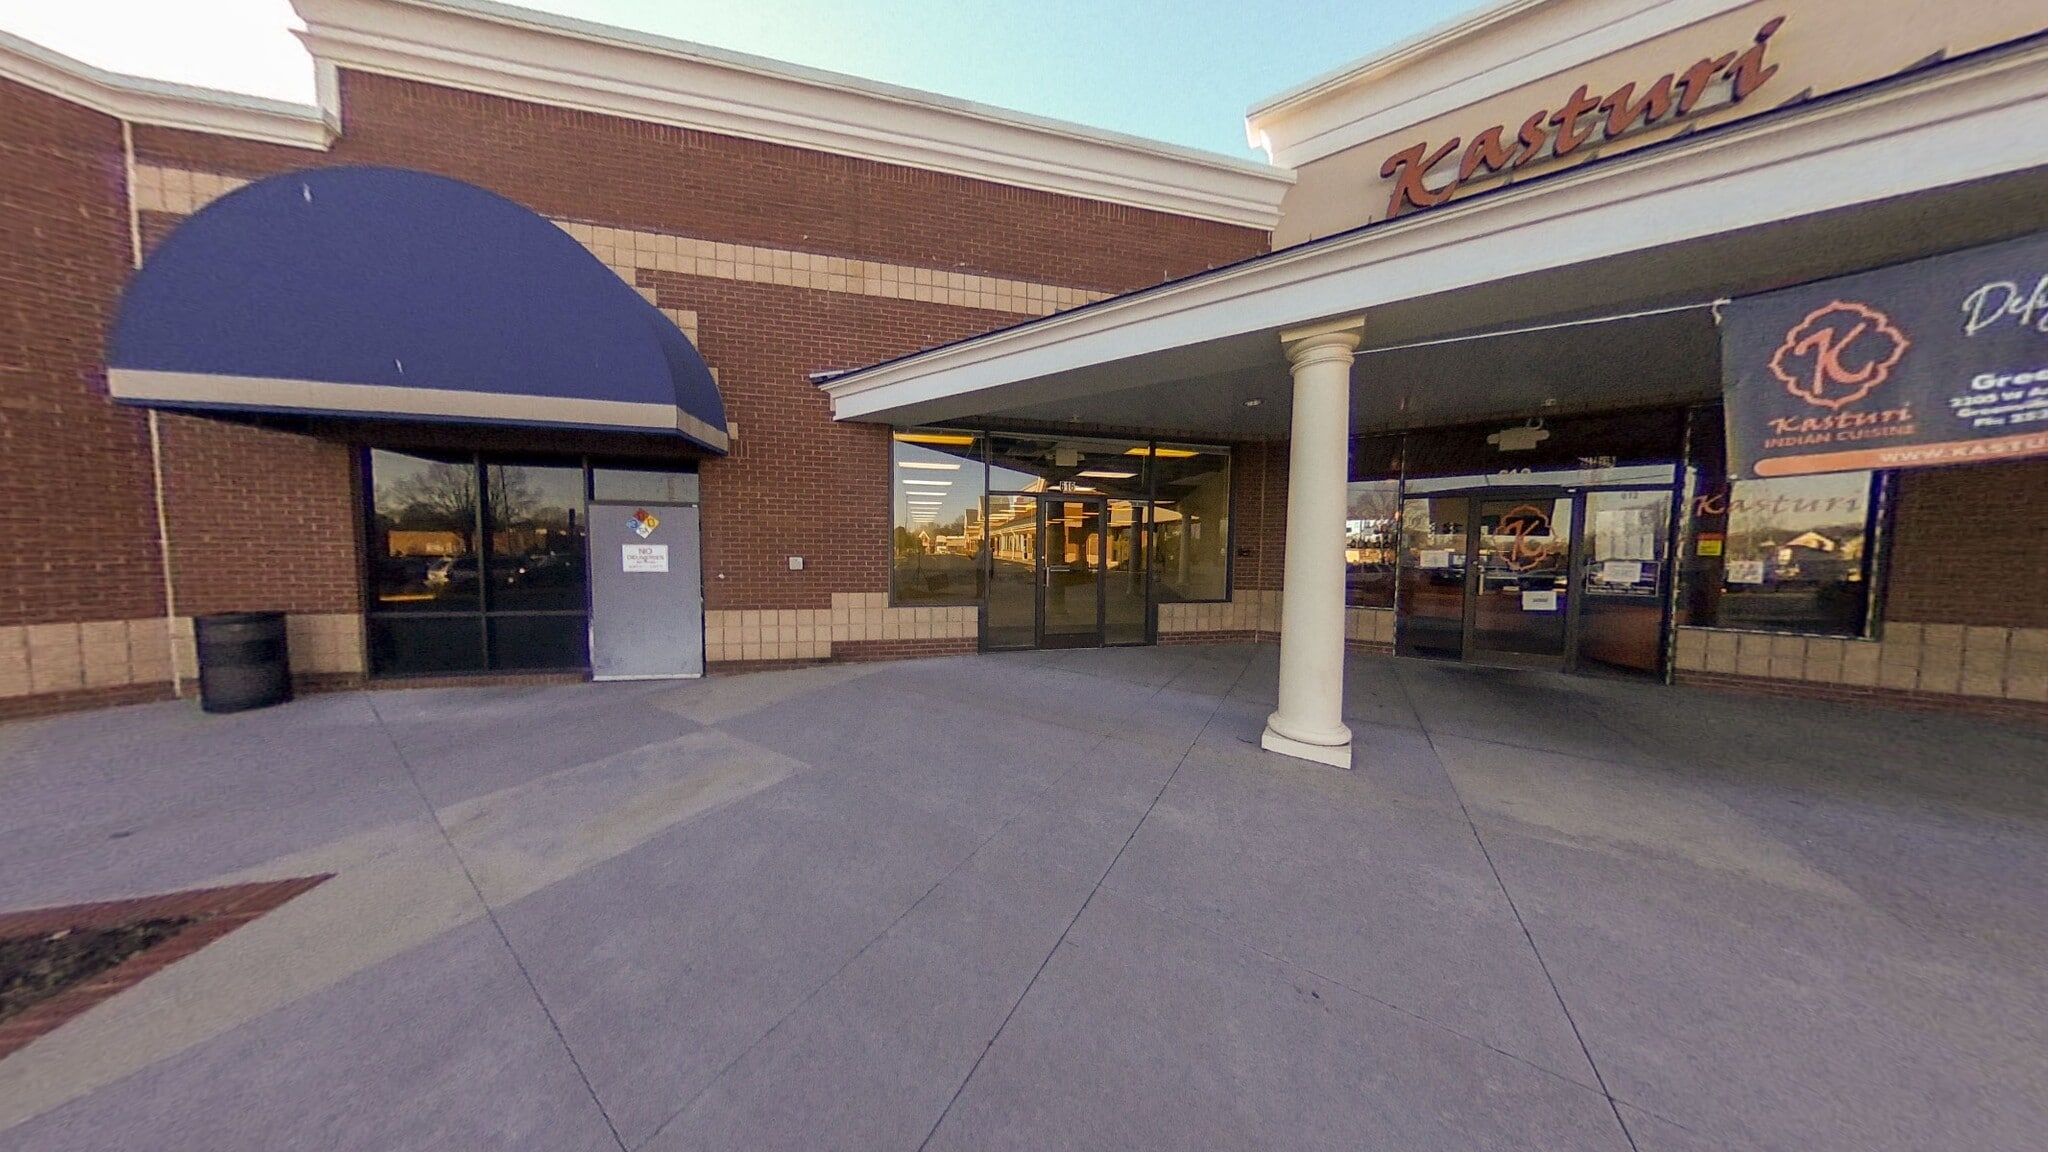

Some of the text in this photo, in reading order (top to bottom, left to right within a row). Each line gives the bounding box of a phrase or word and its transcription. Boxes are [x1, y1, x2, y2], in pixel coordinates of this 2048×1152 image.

[1380, 15, 1787, 217] Kasturi
[1768, 402, 1913, 434] Kasturi
[1764, 432, 1831, 449] INDIAN
[1695, 488, 1862, 517] Kasturi
